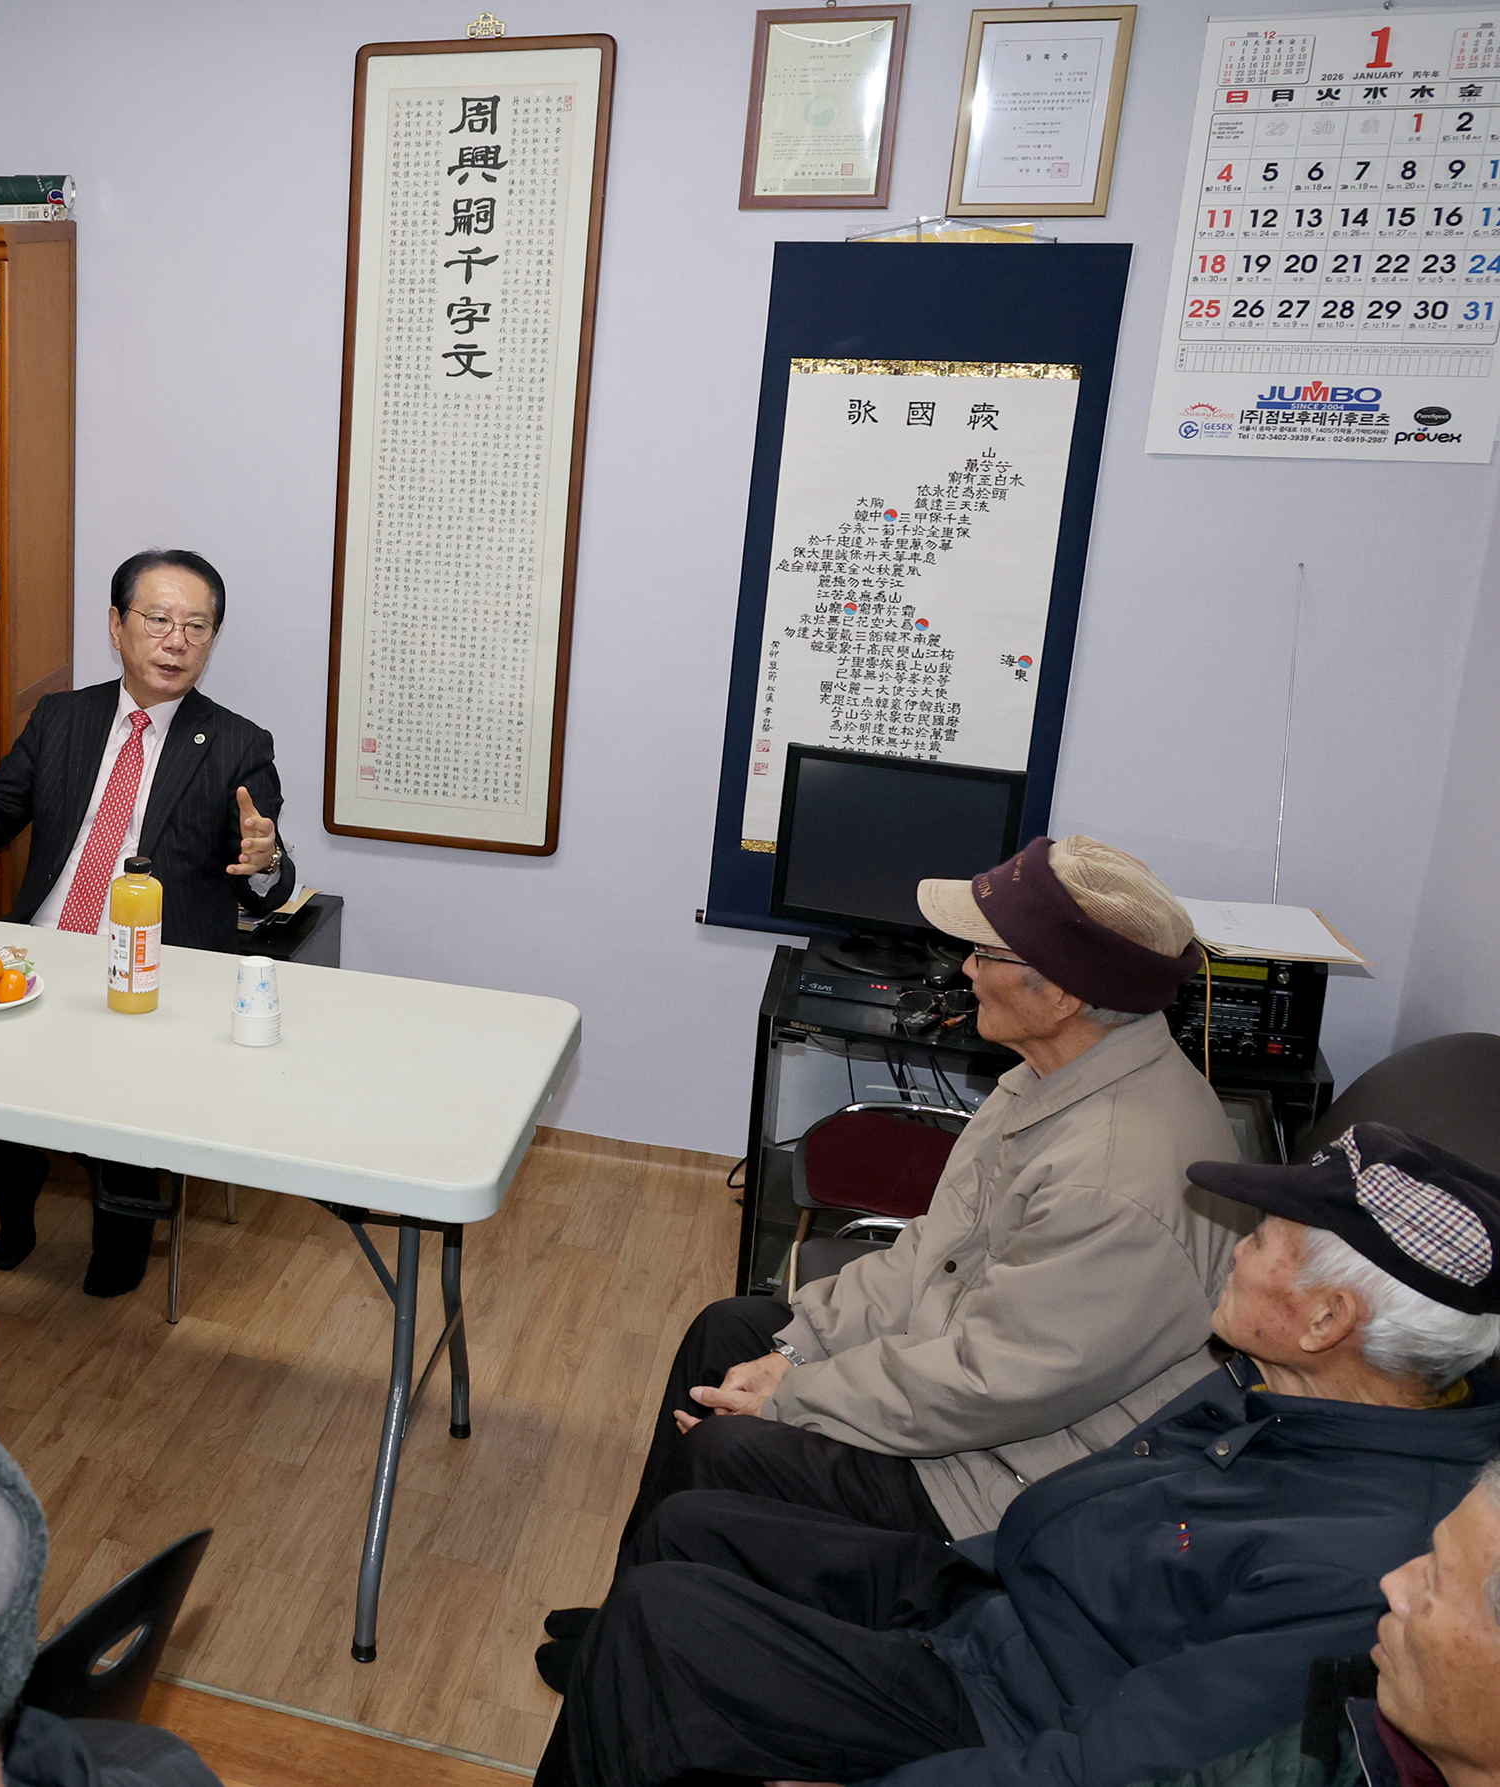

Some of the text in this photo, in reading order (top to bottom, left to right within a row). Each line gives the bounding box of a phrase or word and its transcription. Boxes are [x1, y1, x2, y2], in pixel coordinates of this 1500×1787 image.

[1263, 30, 1276, 39] 12
[1365, 26, 1393, 68] 1
[1321, 73, 1344, 81] 2026
[1352, 71, 1404, 80] JANUARY
[1226, 84, 1483, 103] 日 月 火 水 木 金
[1413, 113, 1423, 132] 1
[1456, 112, 1474, 132] 2
[1217, 163, 1233, 182] 4
[1262, 162, 1279, 182] 5
[1307, 162, 1324, 181] 6
[1355, 161, 1371, 180] 7
[1401, 160, 1416, 180] 8
[1448, 159, 1466, 180] 9
[1207, 209, 1232, 228] 11
[1250, 209, 1279, 227] 12
[1295, 208, 1323, 227] 13
[1340, 207, 1369, 227] 14
[1387, 207, 1416, 226] 15
[1434, 207, 1463, 226] 16
[442, 95, 508, 379] 周興嗣千字文
[1199, 254, 1500, 274] 18 19 20 21 22 23 24
[1188, 299, 1494, 320] 25 26 27 28 29 30 31
[1257, 381, 1382, 403] JUMBO
[1290, 402, 1319, 410] SINCE
[1204, 422, 1233, 430] GESEX
